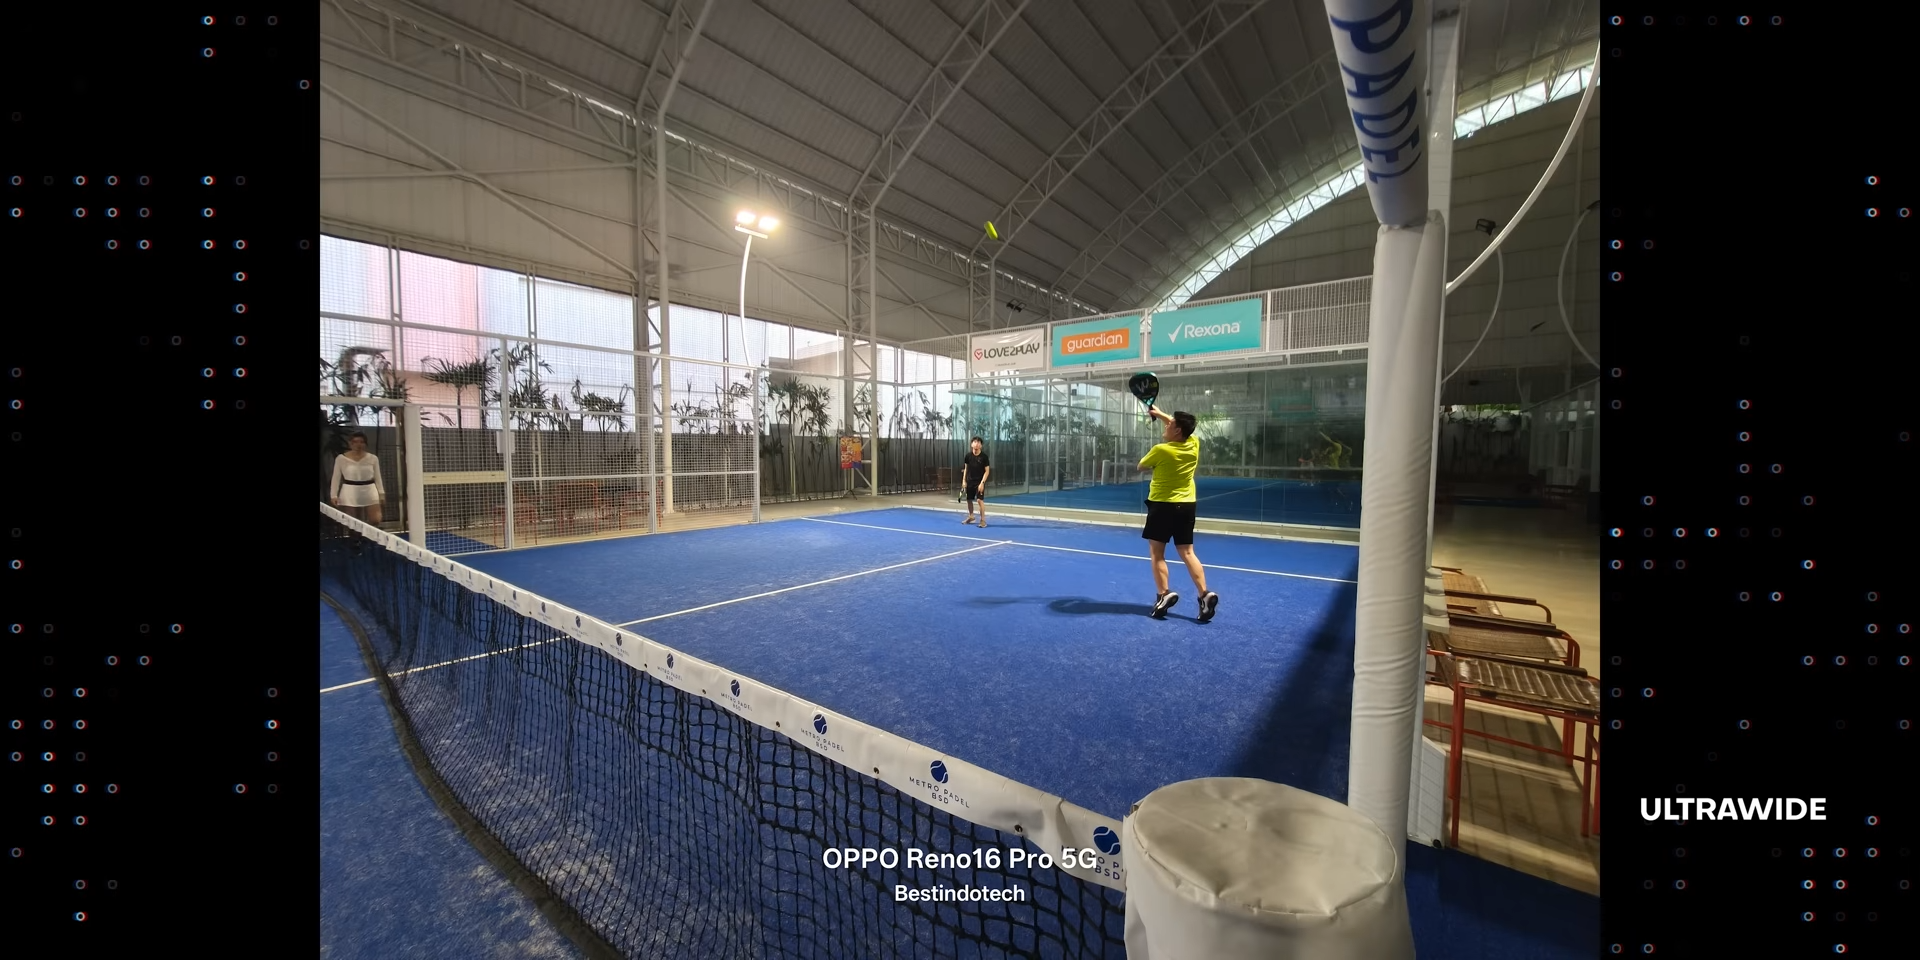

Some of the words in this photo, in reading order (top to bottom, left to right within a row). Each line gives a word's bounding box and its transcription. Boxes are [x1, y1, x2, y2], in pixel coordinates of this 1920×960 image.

[1330, 0, 1422, 184] PADEL
[1184, 322, 1240, 339] Rexona
[983, 342, 1040, 359] LOVE2PLAY
[1067, 333, 1123, 352] guardian
[801, 727, 821, 741] METRO
[823, 738, 845, 752] PADEL
[909, 776, 940, 792] METRO
[943, 788, 970, 808] PADEL
[931, 792, 949, 804] BSD
[1094, 864, 1120, 880] BSD
